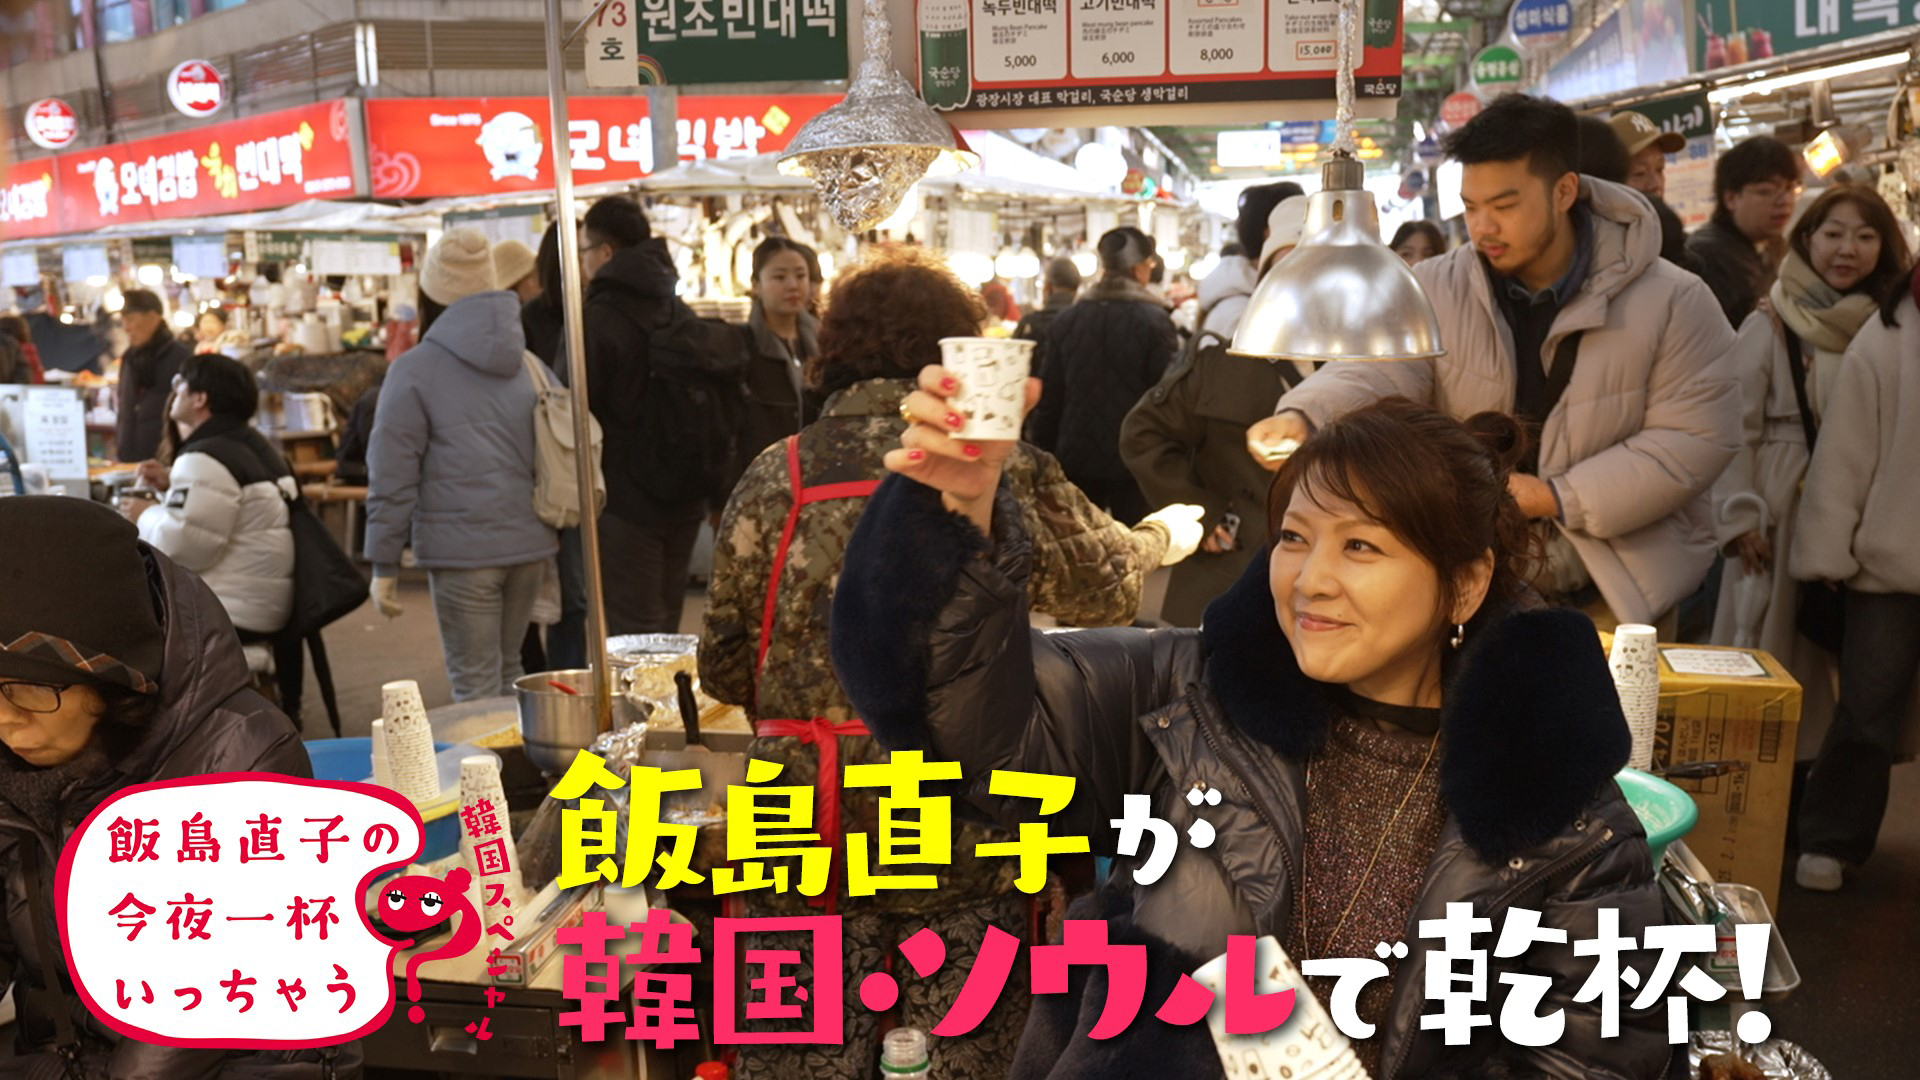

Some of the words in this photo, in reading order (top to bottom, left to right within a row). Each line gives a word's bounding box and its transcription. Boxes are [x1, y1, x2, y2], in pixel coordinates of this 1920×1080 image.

[642, 0, 836, 41] 원조빈대떡
[600, 37, 625, 60] 호
[1200, 48, 1233, 62] 8,000
[1004, 55, 1037, 69] 5,000
[1102, 52, 1135, 65] 6,000
[928, 66, 961, 79] 국순당
[1364, 80, 1397, 95] 국순당
[976, 91, 1025, 107] 광장시장
[1028, 91, 1052, 105] 대표
[1100, 88, 1136, 103] 국순당
[1140, 86, 1189, 101] 생막걸리
